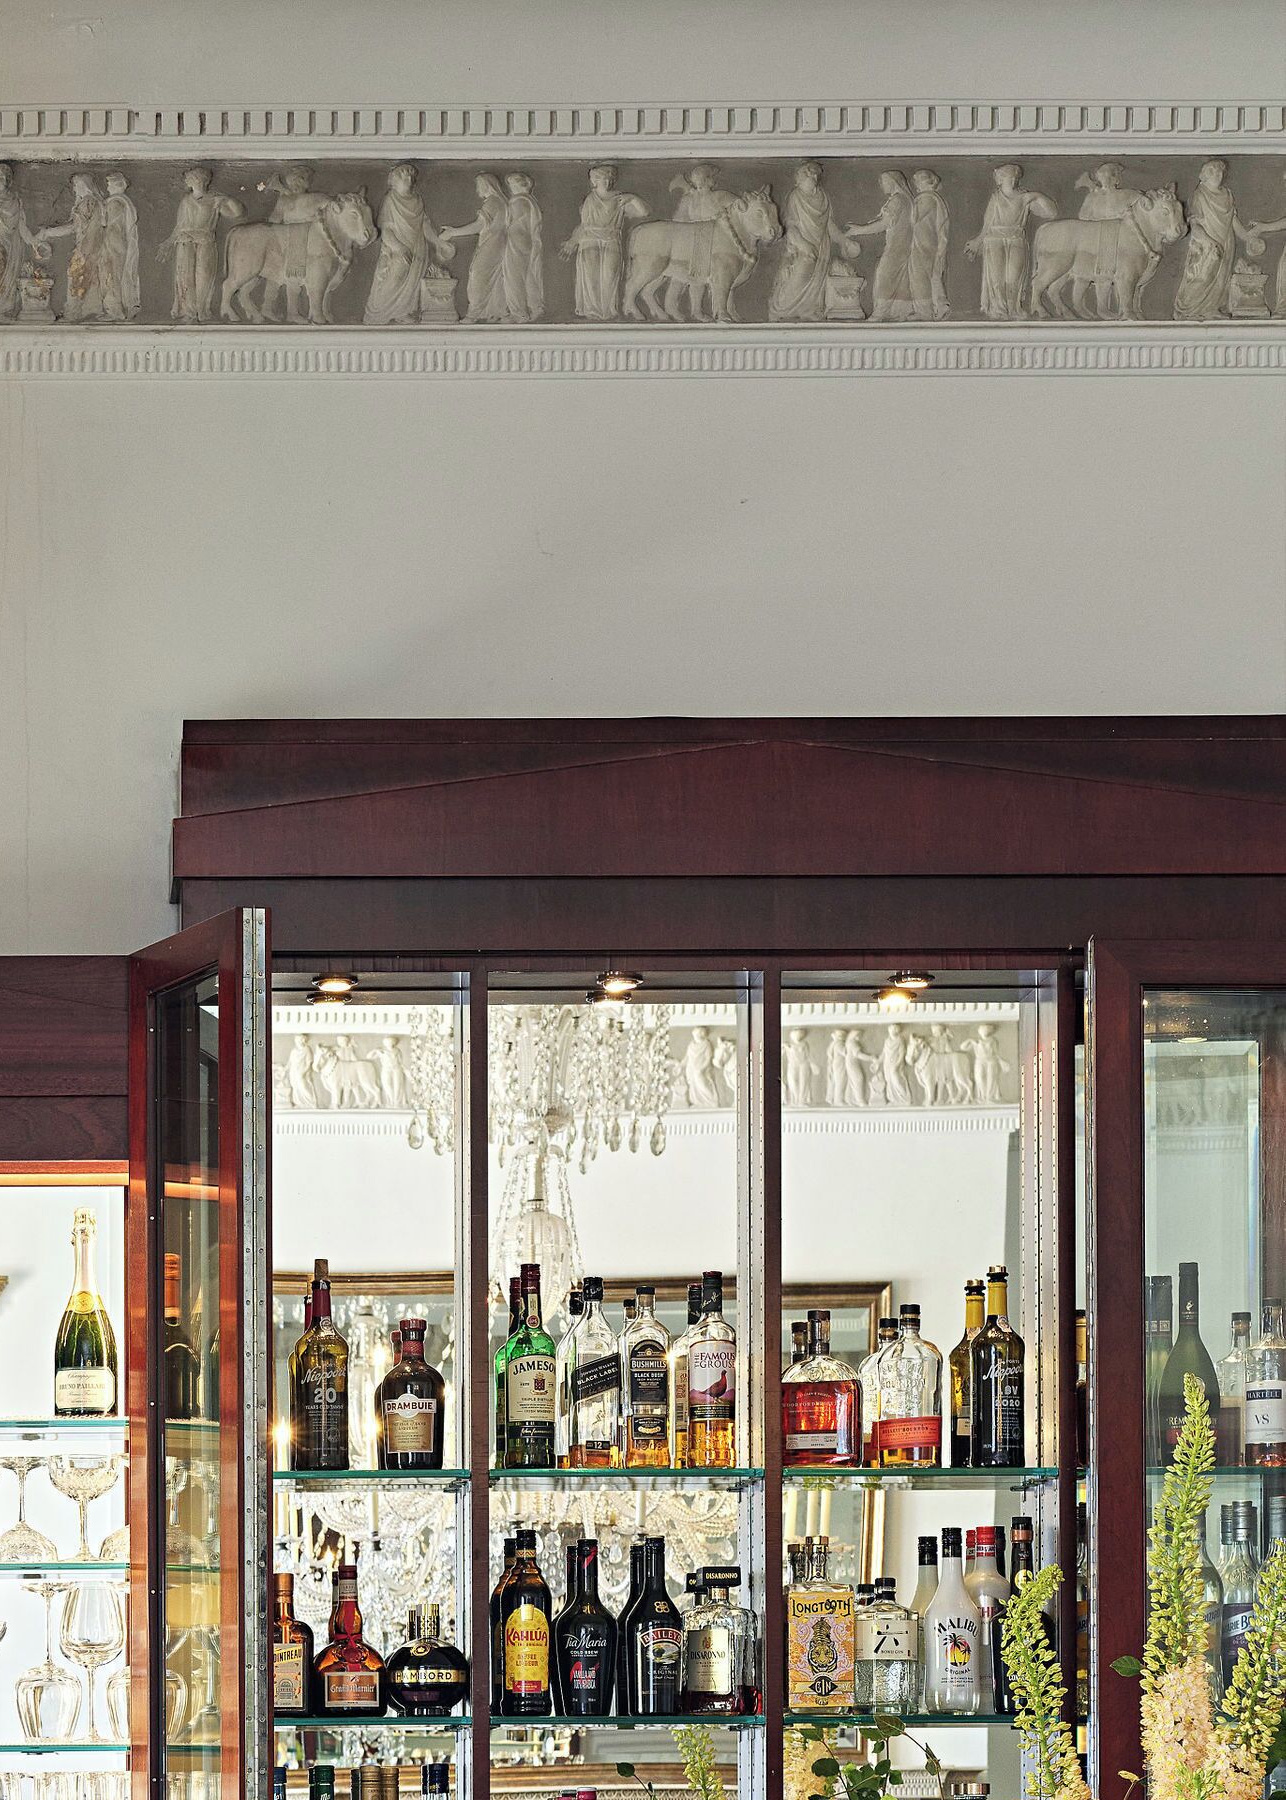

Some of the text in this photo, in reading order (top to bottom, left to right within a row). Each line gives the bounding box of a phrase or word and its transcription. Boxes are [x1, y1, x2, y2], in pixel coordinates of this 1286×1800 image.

[700, 1352, 735, 1360] FAMOUS
[513, 1360, 555, 1375] JAMESO
[631, 1360, 667, 1368] BUSHMILLS
[577, 1367, 618, 1386] BLACK LABEL
[314, 1387, 337, 1403] 20
[386, 1401, 433, 1411] DRAMBUIE
[995, 1399, 1021, 1407] 2020
[1254, 1414, 1270, 1425] VS
[594, 1441, 603, 1449] 12
[790, 1597, 853, 1617] LONGTOOTH
[934, 1617, 978, 1638] MALIBU
[506, 1627, 548, 1647] KAHLÚA
[563, 1633, 607, 1650] Tia Maria
[643, 1630, 681, 1643] BAILEYS
[690, 1651, 725, 1659] DISARONNO
[351, 1684, 375, 1693] Marnier
[815, 1680, 832, 1695] GIN
